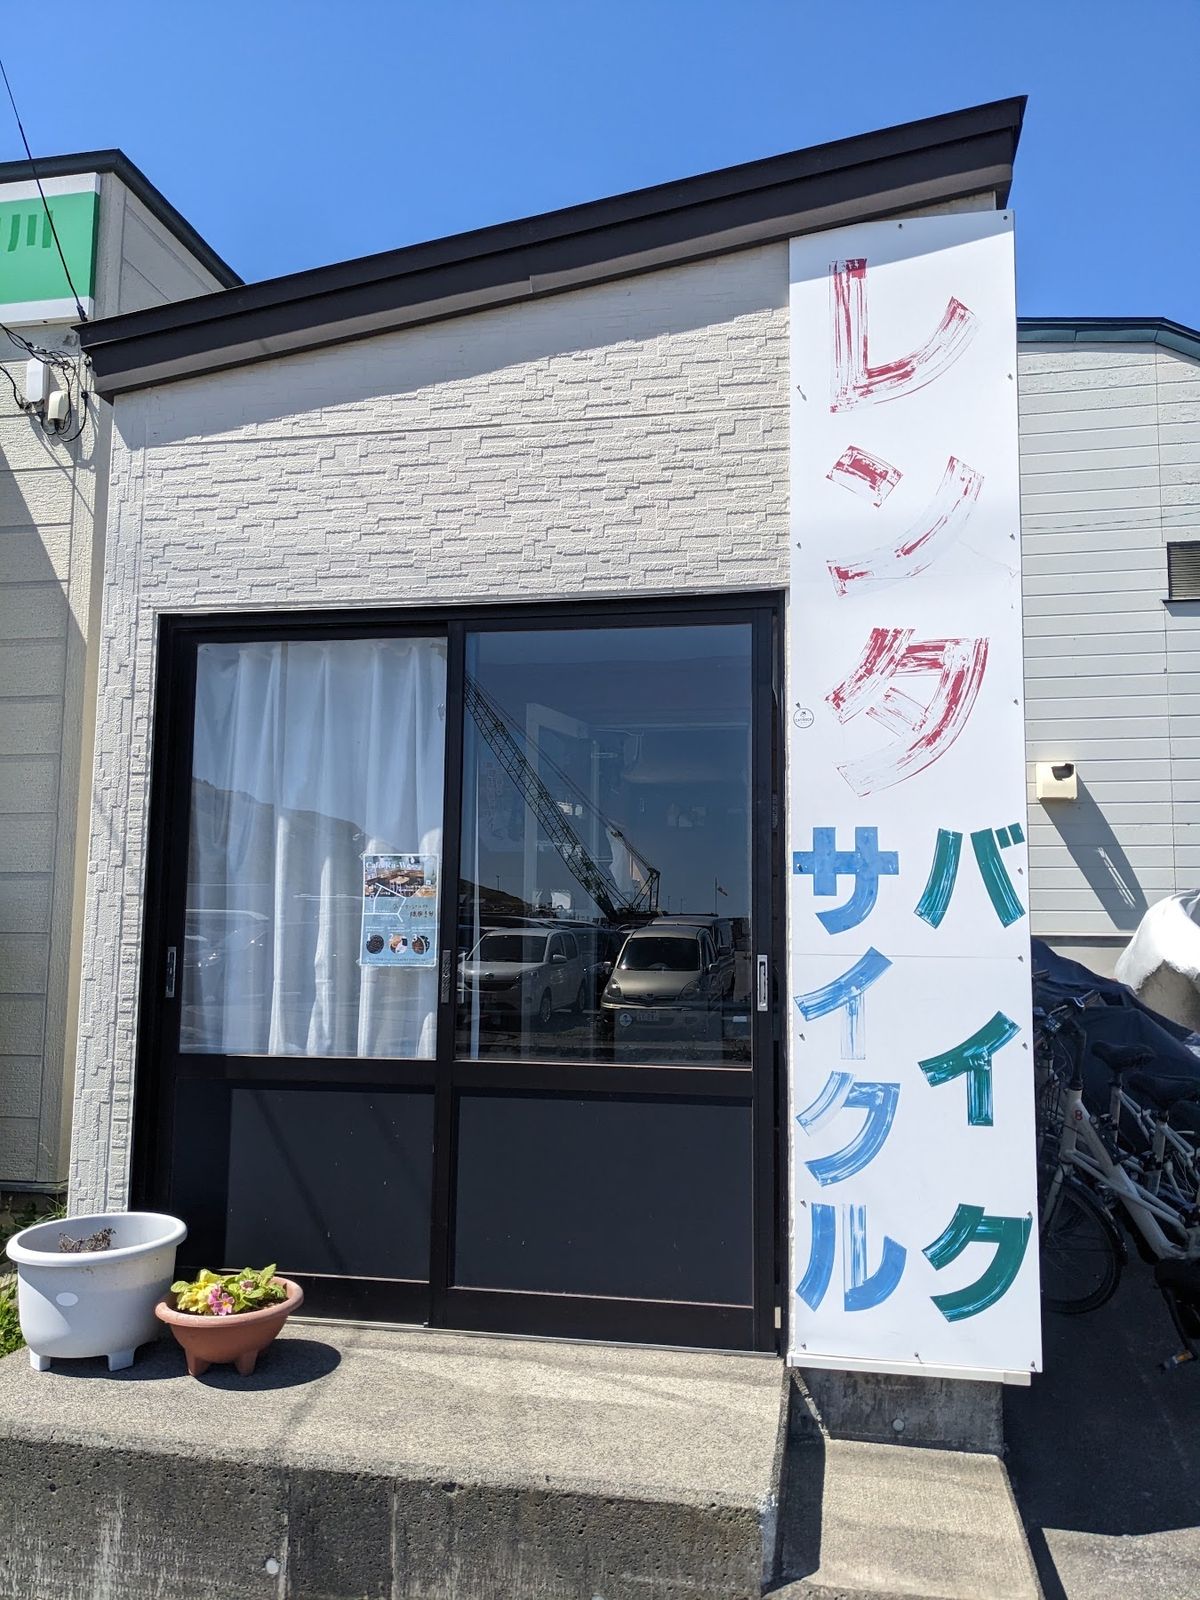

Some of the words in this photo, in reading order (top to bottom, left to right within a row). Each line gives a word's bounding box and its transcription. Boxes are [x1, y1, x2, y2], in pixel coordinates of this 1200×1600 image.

[0, 210, 54, 252] 川
[824, 257, 990, 798] レンタ
[792, 826, 907, 1313] サイクル
[913, 822, 1033, 1323] バイク
